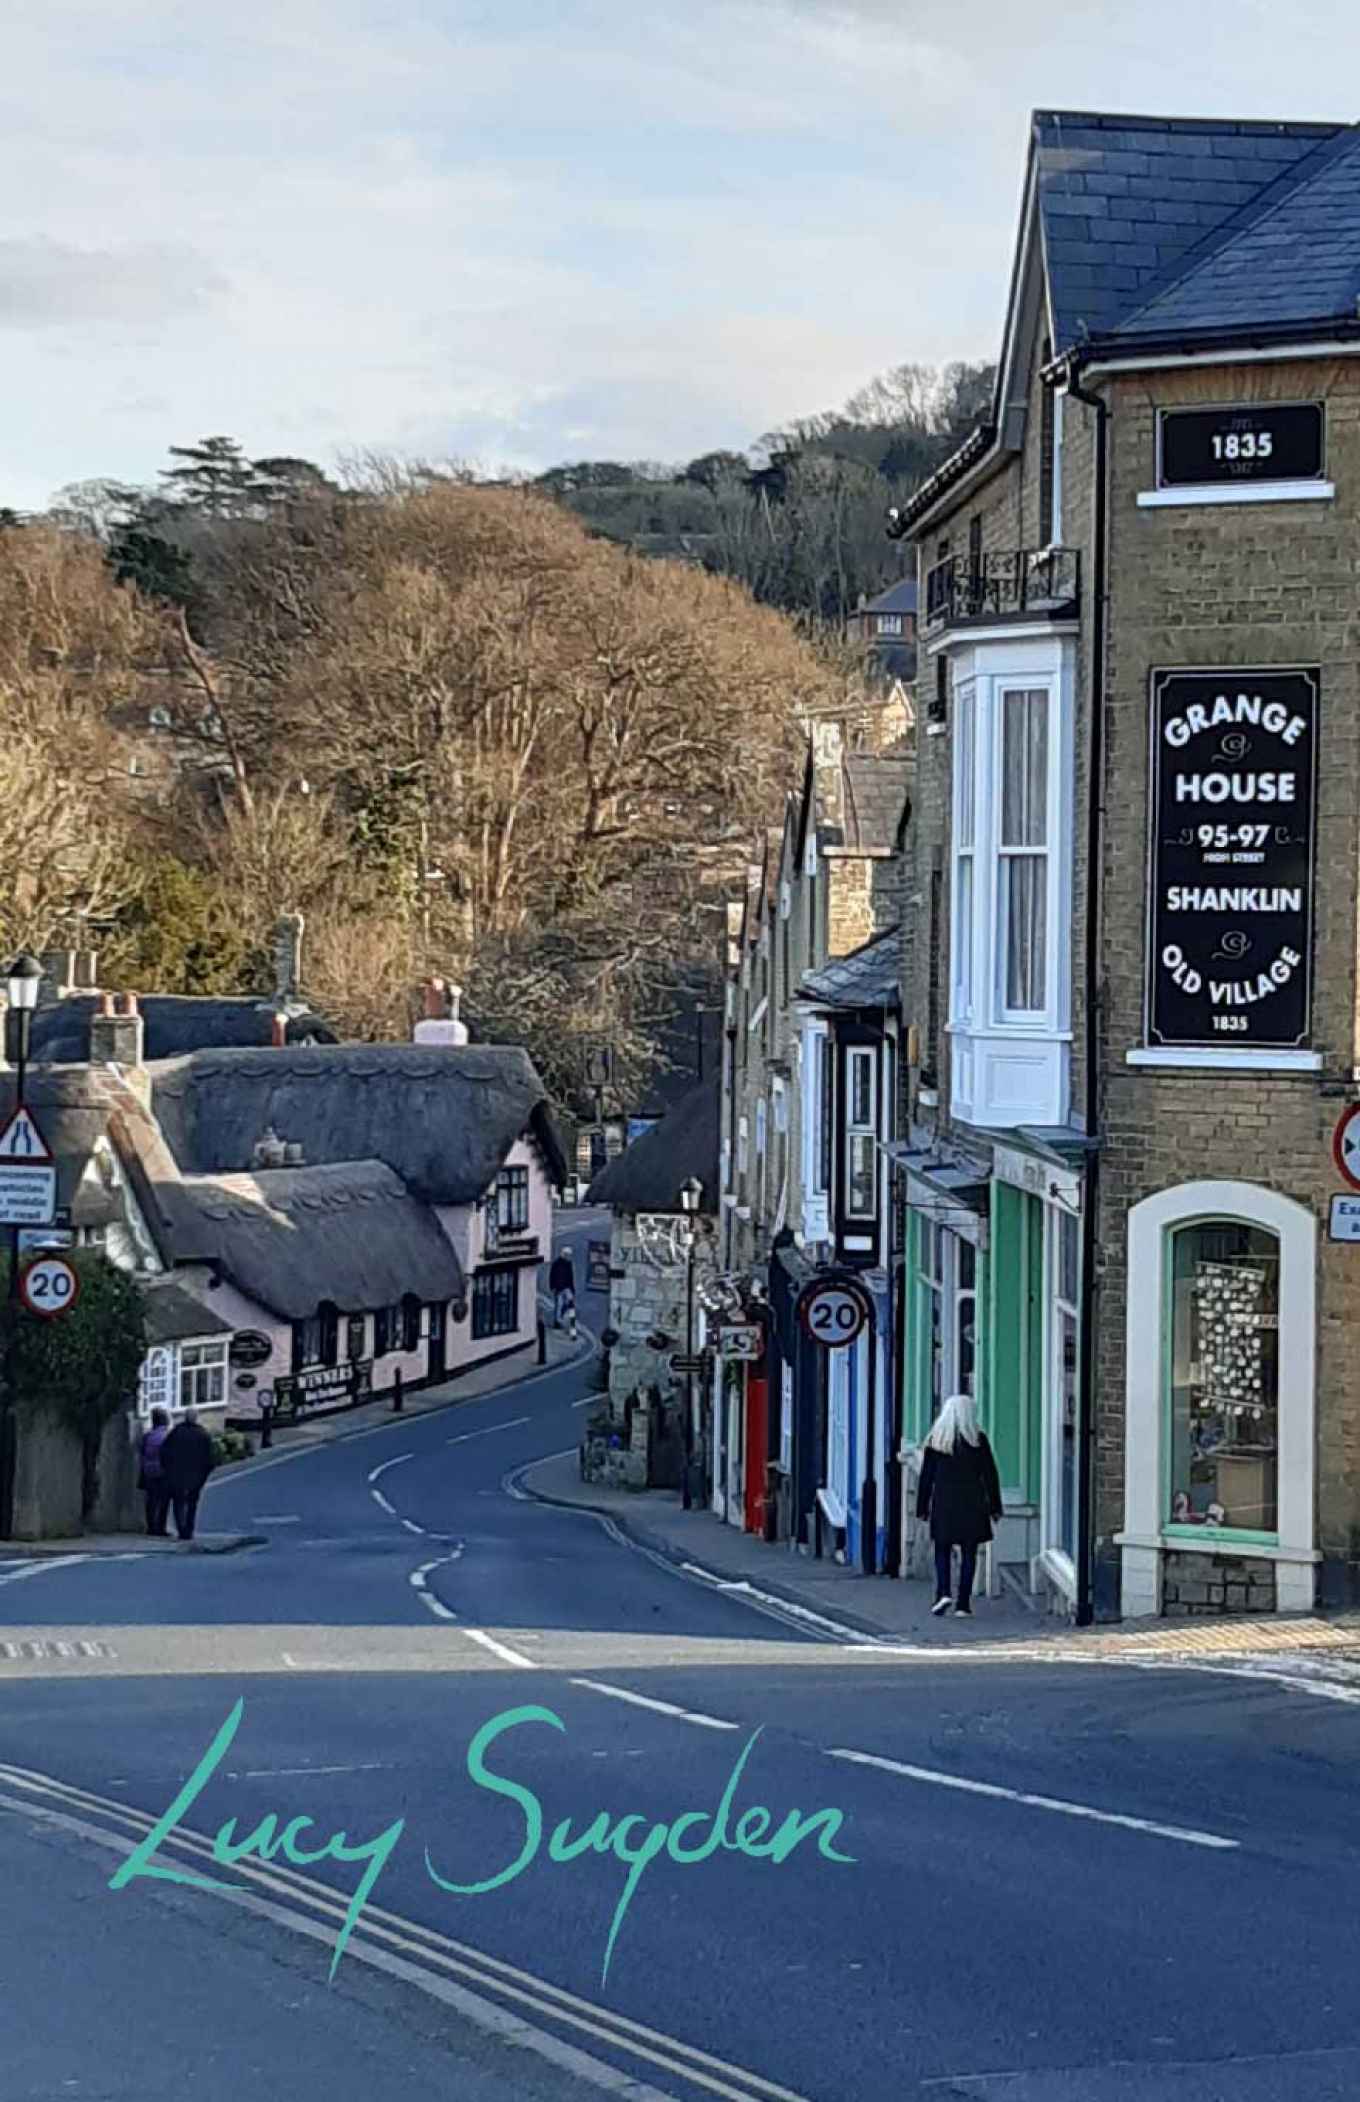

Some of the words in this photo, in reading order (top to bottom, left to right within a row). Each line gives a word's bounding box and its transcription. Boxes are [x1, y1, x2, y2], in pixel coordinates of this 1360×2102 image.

[1213, 433, 1272, 458] 1835
[1165, 695, 1305, 748] GRANGE
[1177, 773, 1294, 802] HOUSE
[1199, 825, 1269, 847] 95-97
[1168, 887, 1300, 911] SHANKLIN
[1163, 945, 1201, 993] OLD
[1210, 943, 1300, 1004] VILLAGE
[1213, 1017, 1247, 1030] 1835
[32, 1273, 71, 1297] 20
[813, 1302, 857, 1331] 20
